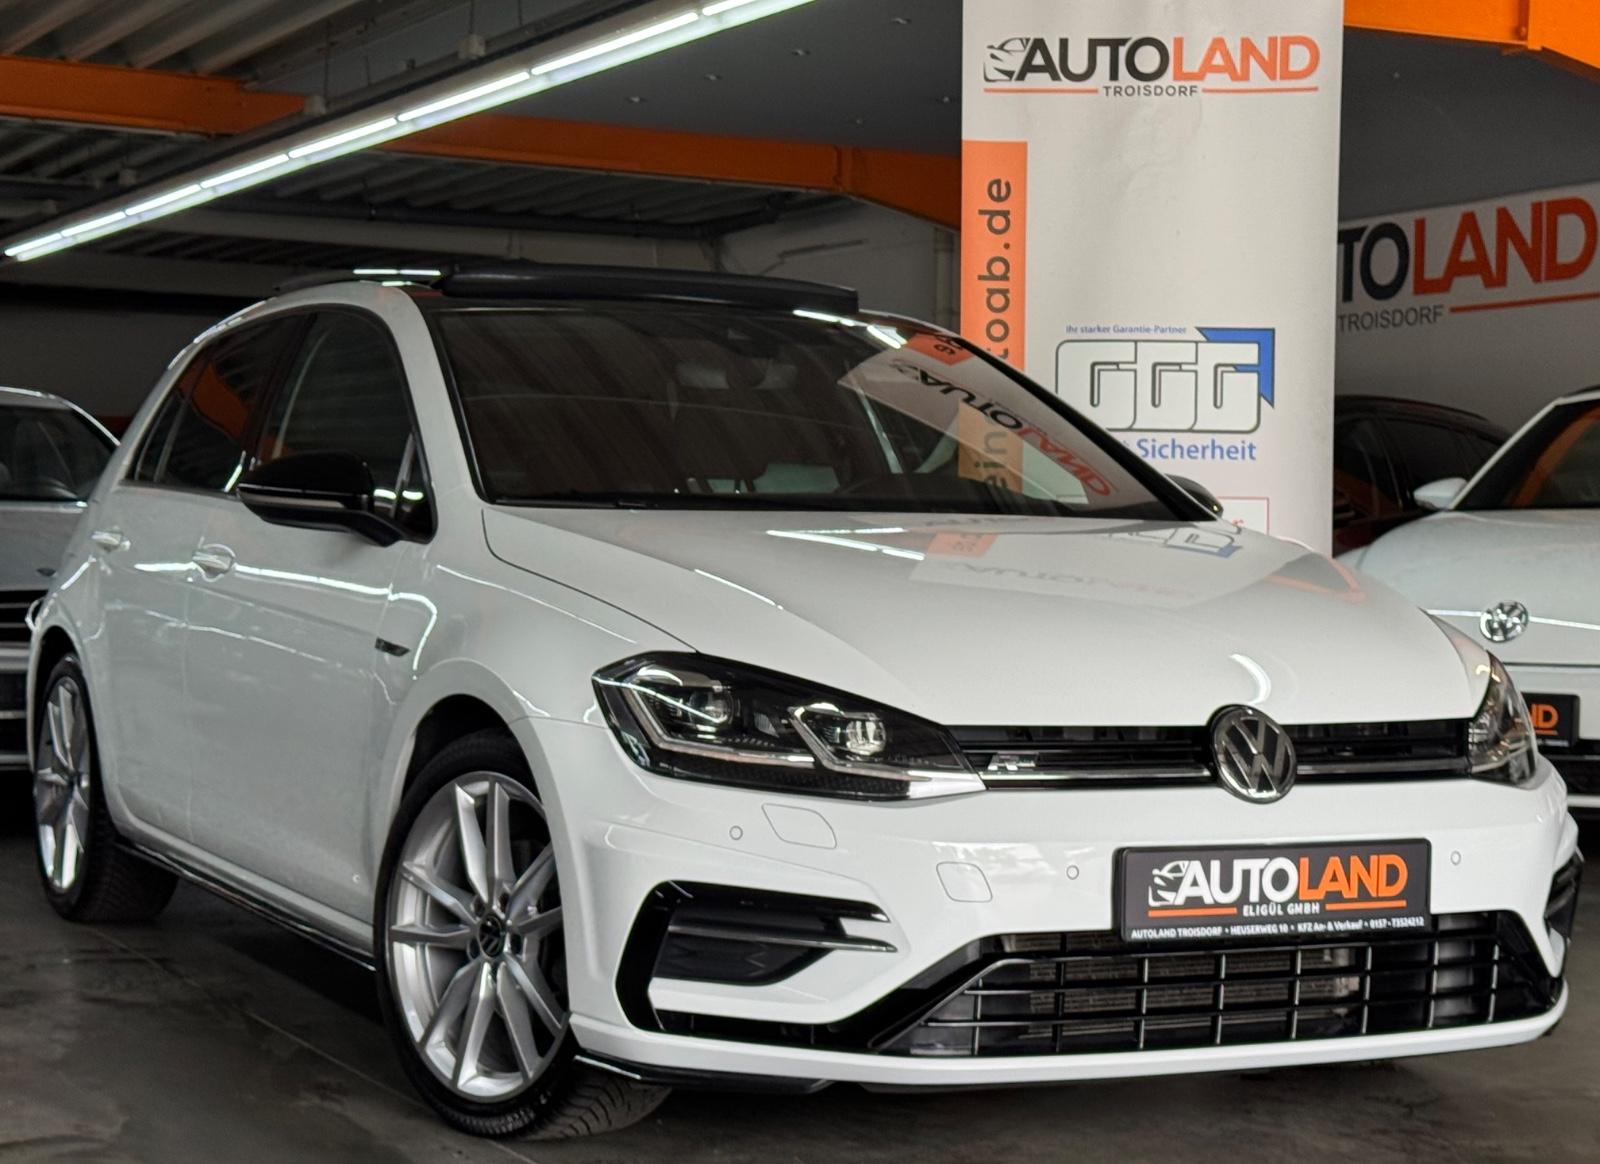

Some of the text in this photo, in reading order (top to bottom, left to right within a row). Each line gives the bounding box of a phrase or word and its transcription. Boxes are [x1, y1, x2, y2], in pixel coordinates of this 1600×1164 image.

[1014, 35, 1321, 83] AUTOLAND
[1102, 85, 1199, 98] TROISDORF
[1337, 196, 1599, 303] TOLAND
[1338, 304, 1444, 332] TROISDORF
[1065, 325, 1187, 335] Ihr starker Garantie-Partner
[1136, 438, 1257, 461] Sicherheit
[1173, 853, 1409, 906] AUTOLAND
[1242, 901, 1321, 917] ELIGÜL GMBH
[1131, 927, 1177, 939] AUTOLAND
[1177, 925, 1223, 938] TROISDORF
[1297, 921, 1313, 934] KFZ
[1334, 918, 1363, 931] Verkauf
